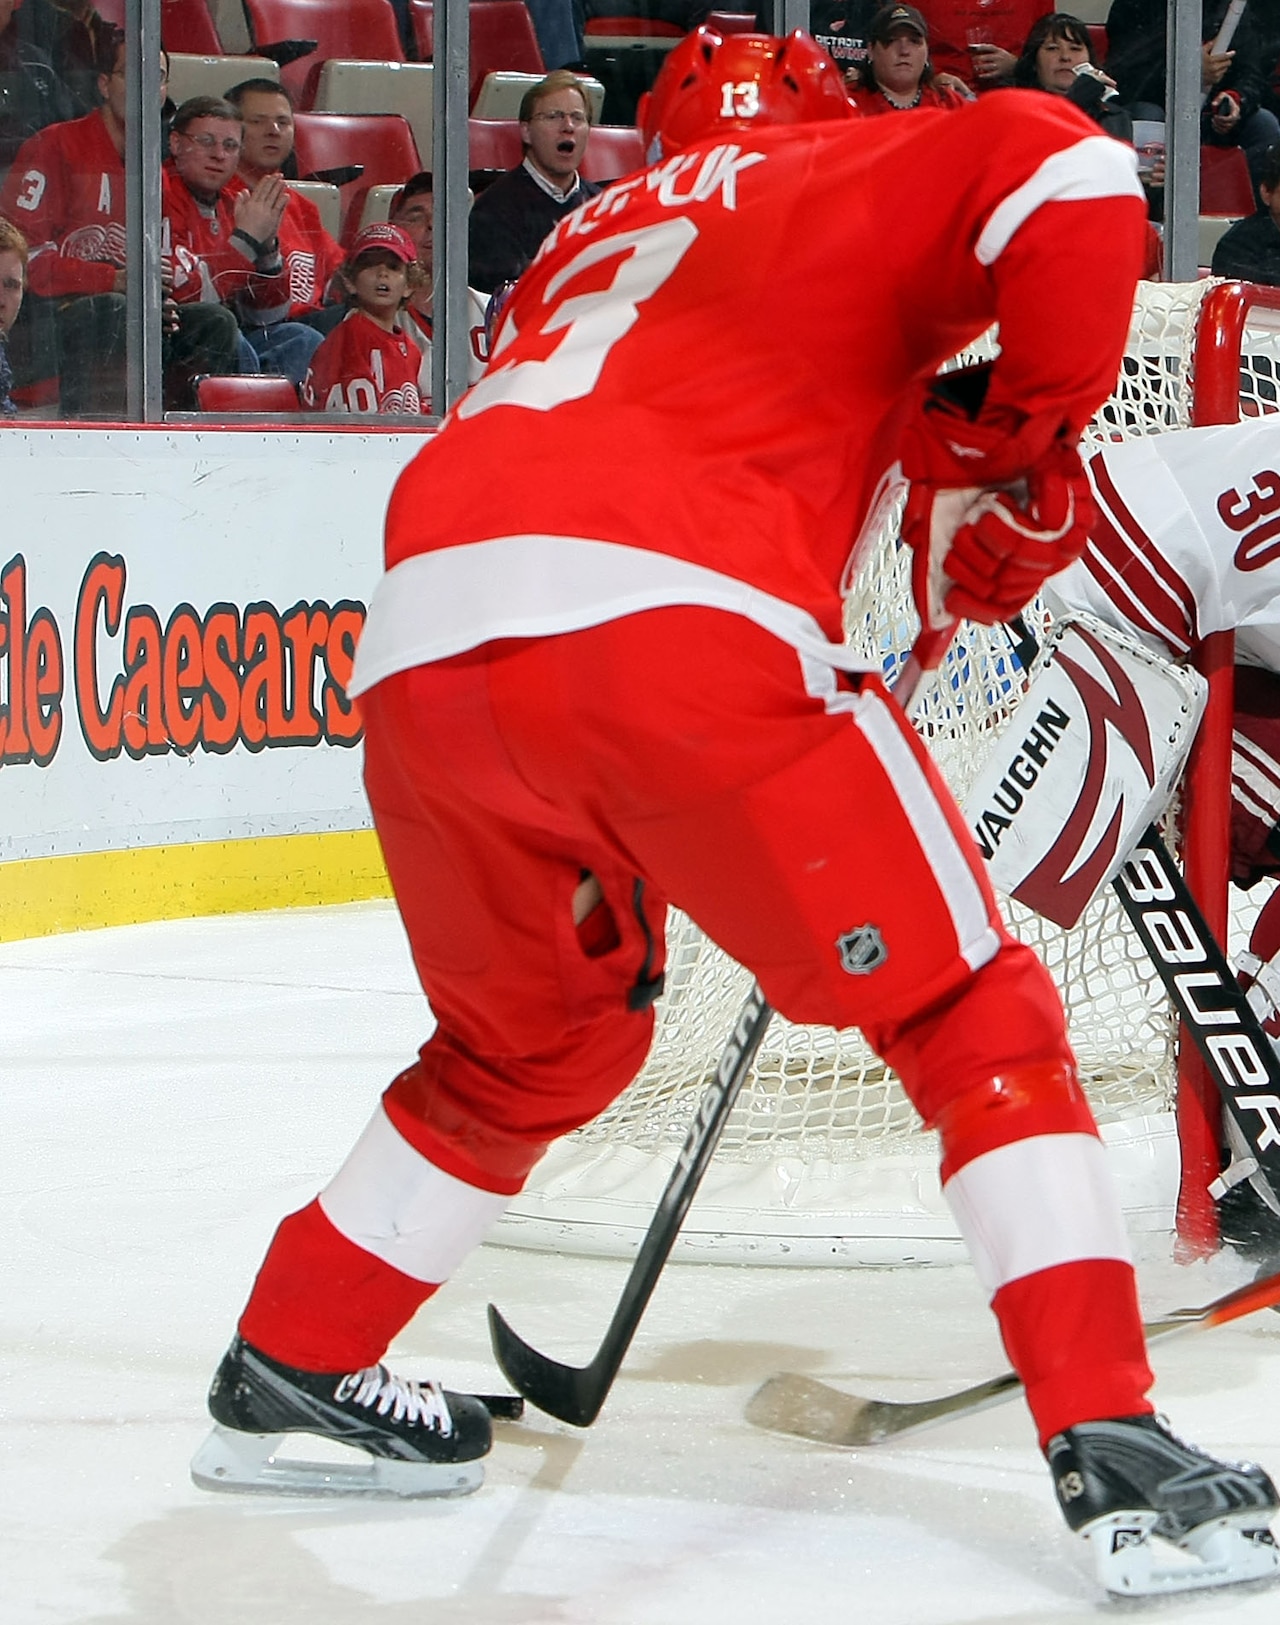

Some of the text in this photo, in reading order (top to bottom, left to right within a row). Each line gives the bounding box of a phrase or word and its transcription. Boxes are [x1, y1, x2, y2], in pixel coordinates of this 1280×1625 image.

[815, 34, 863, 47] DETROIT
[720, 82, 759, 118] 13
[16, 170, 46, 211] 3
[97, 172, 111, 214] A
[456, 216, 700, 420] 3
[325, 377, 379, 416] 40
[75, 551, 366, 762] Caesars
[975, 697, 1071, 861] VAUGHN
